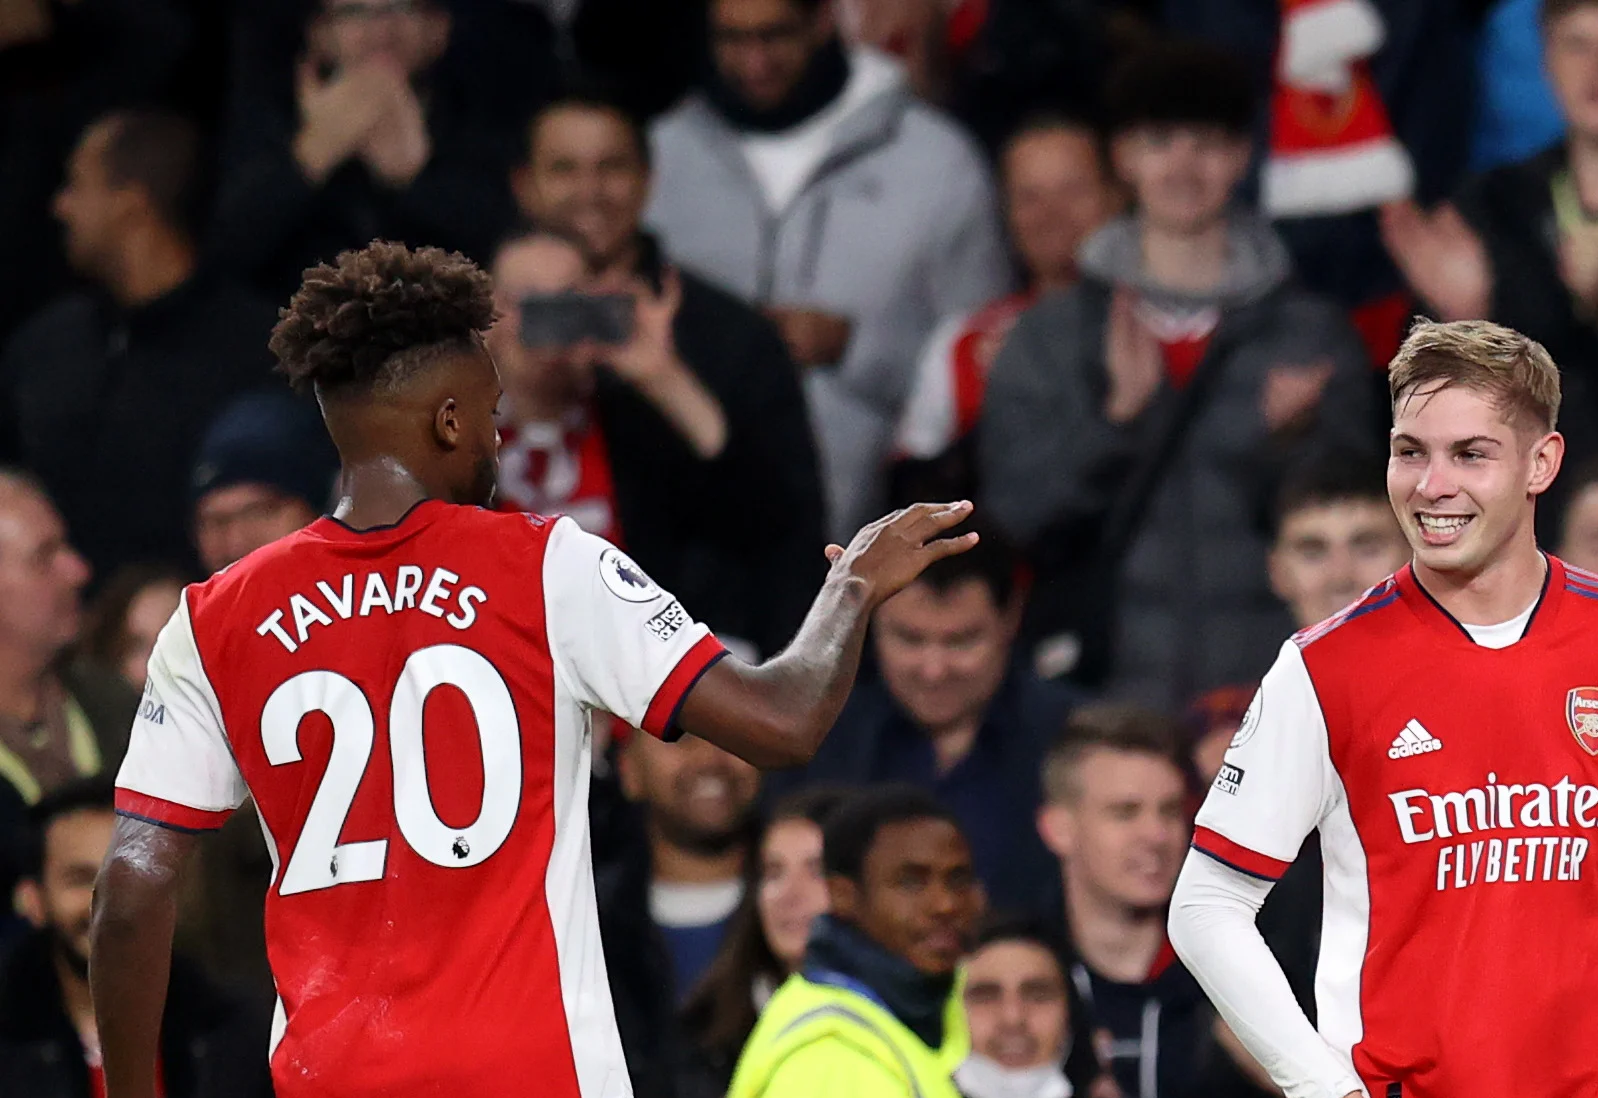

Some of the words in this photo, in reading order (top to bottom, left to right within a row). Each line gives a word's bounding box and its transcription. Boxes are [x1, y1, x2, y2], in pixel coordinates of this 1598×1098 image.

[257, 565, 487, 654] TAVARES
[260, 644, 522, 896] 20
[1388, 738, 1442, 759] adidas
